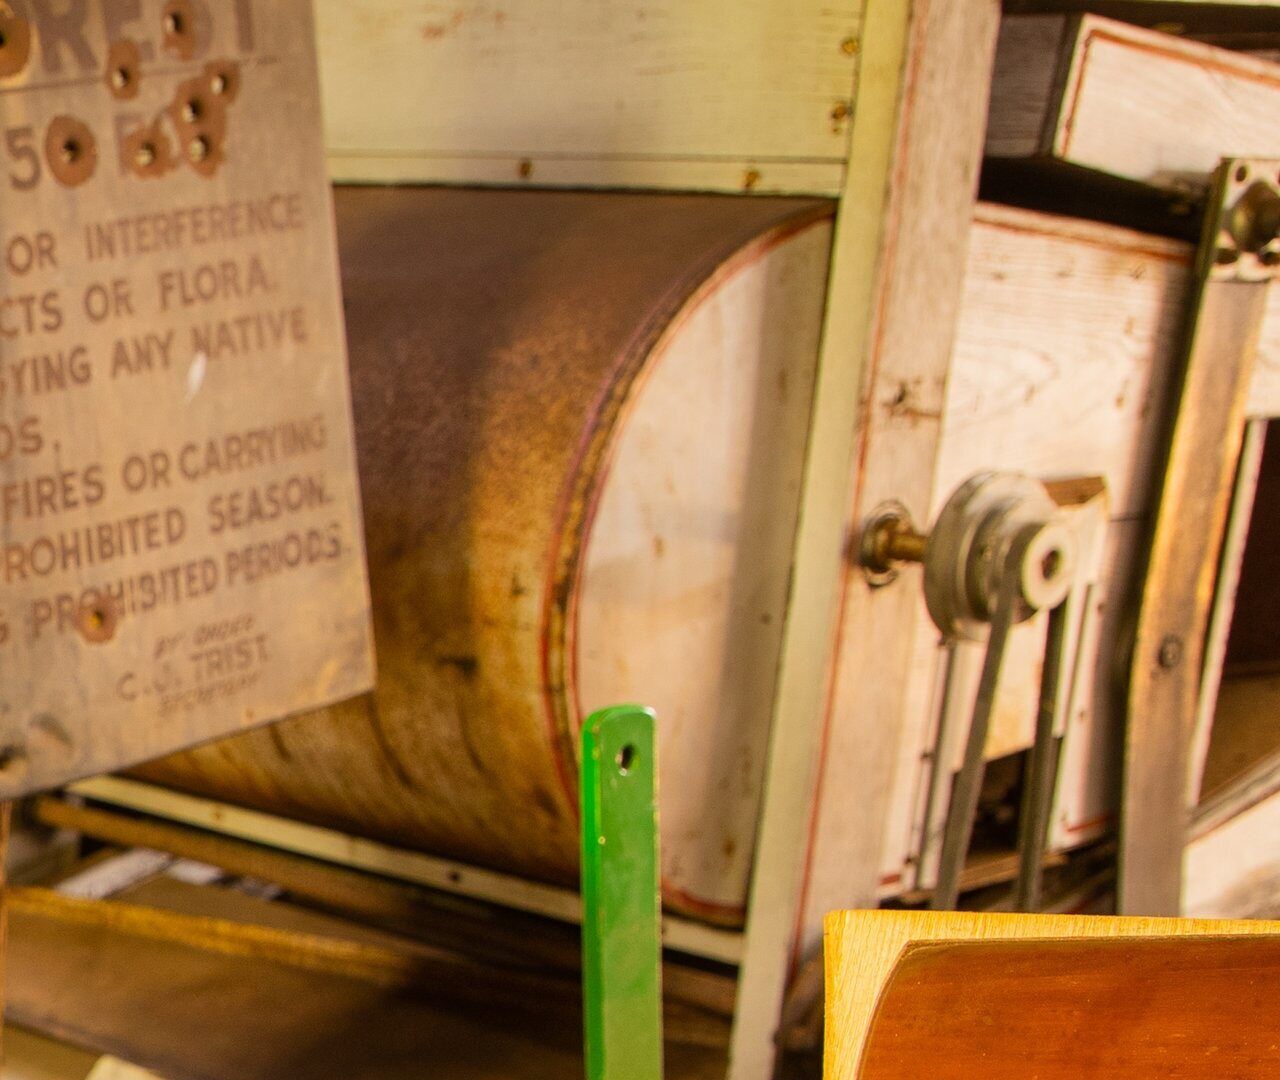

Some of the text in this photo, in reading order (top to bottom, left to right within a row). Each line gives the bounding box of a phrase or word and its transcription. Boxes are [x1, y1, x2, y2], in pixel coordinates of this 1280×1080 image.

[5, 231, 59, 276] OR
[85, 193, 305, 262] INTERFERENCE
[109, 331, 176, 379] ANY
[189, 307, 309, 359] NATIVE
[1, 465, 106, 522] FIRES
[121, 449, 172, 493] OR
[178, 413, 328, 481] CARRYING
